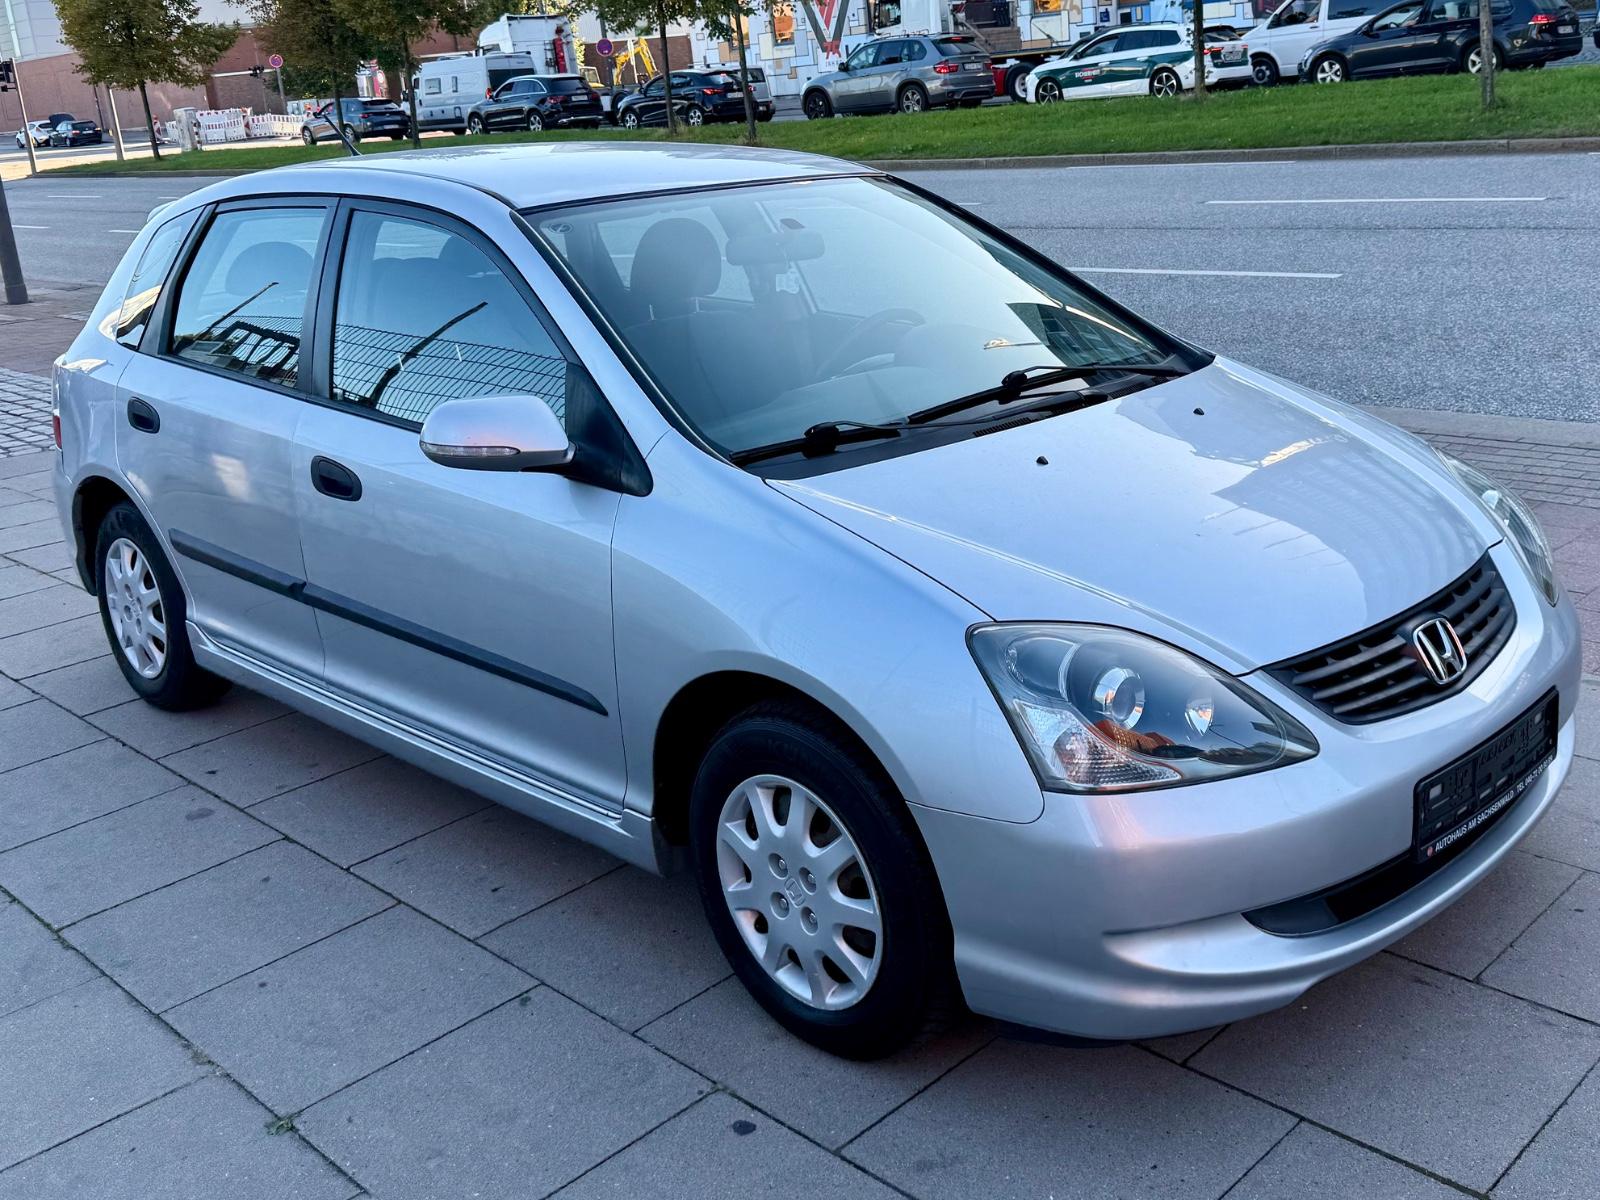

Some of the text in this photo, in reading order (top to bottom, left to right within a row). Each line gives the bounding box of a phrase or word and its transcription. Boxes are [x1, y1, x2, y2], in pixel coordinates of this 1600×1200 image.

[1435, 824, 1467, 853] AUTOHAUS
[1467, 817, 1477, 830] AM
[1477, 790, 1514, 824] SACHSENWALD
